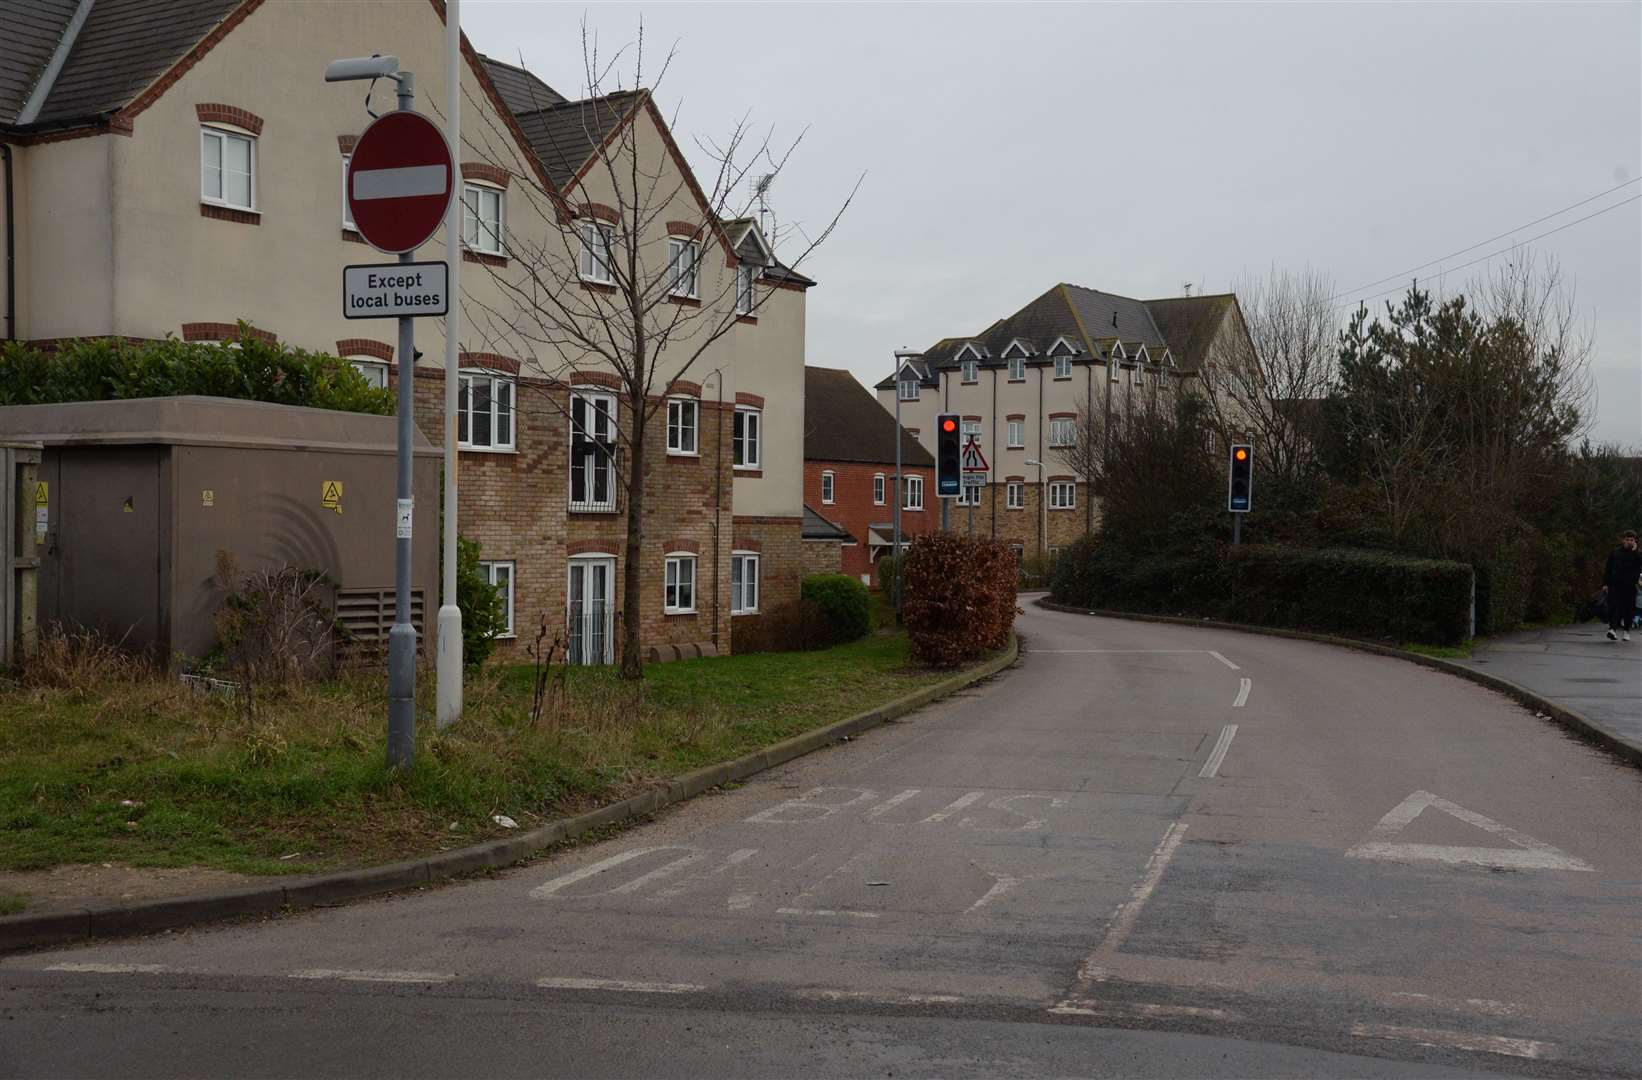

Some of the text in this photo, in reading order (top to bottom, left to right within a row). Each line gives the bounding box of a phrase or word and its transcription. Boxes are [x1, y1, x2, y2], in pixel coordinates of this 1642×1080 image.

[368, 273, 422, 289] Except
[351, 292, 440, 308] local buses
[745, 786, 1073, 832] BUS
